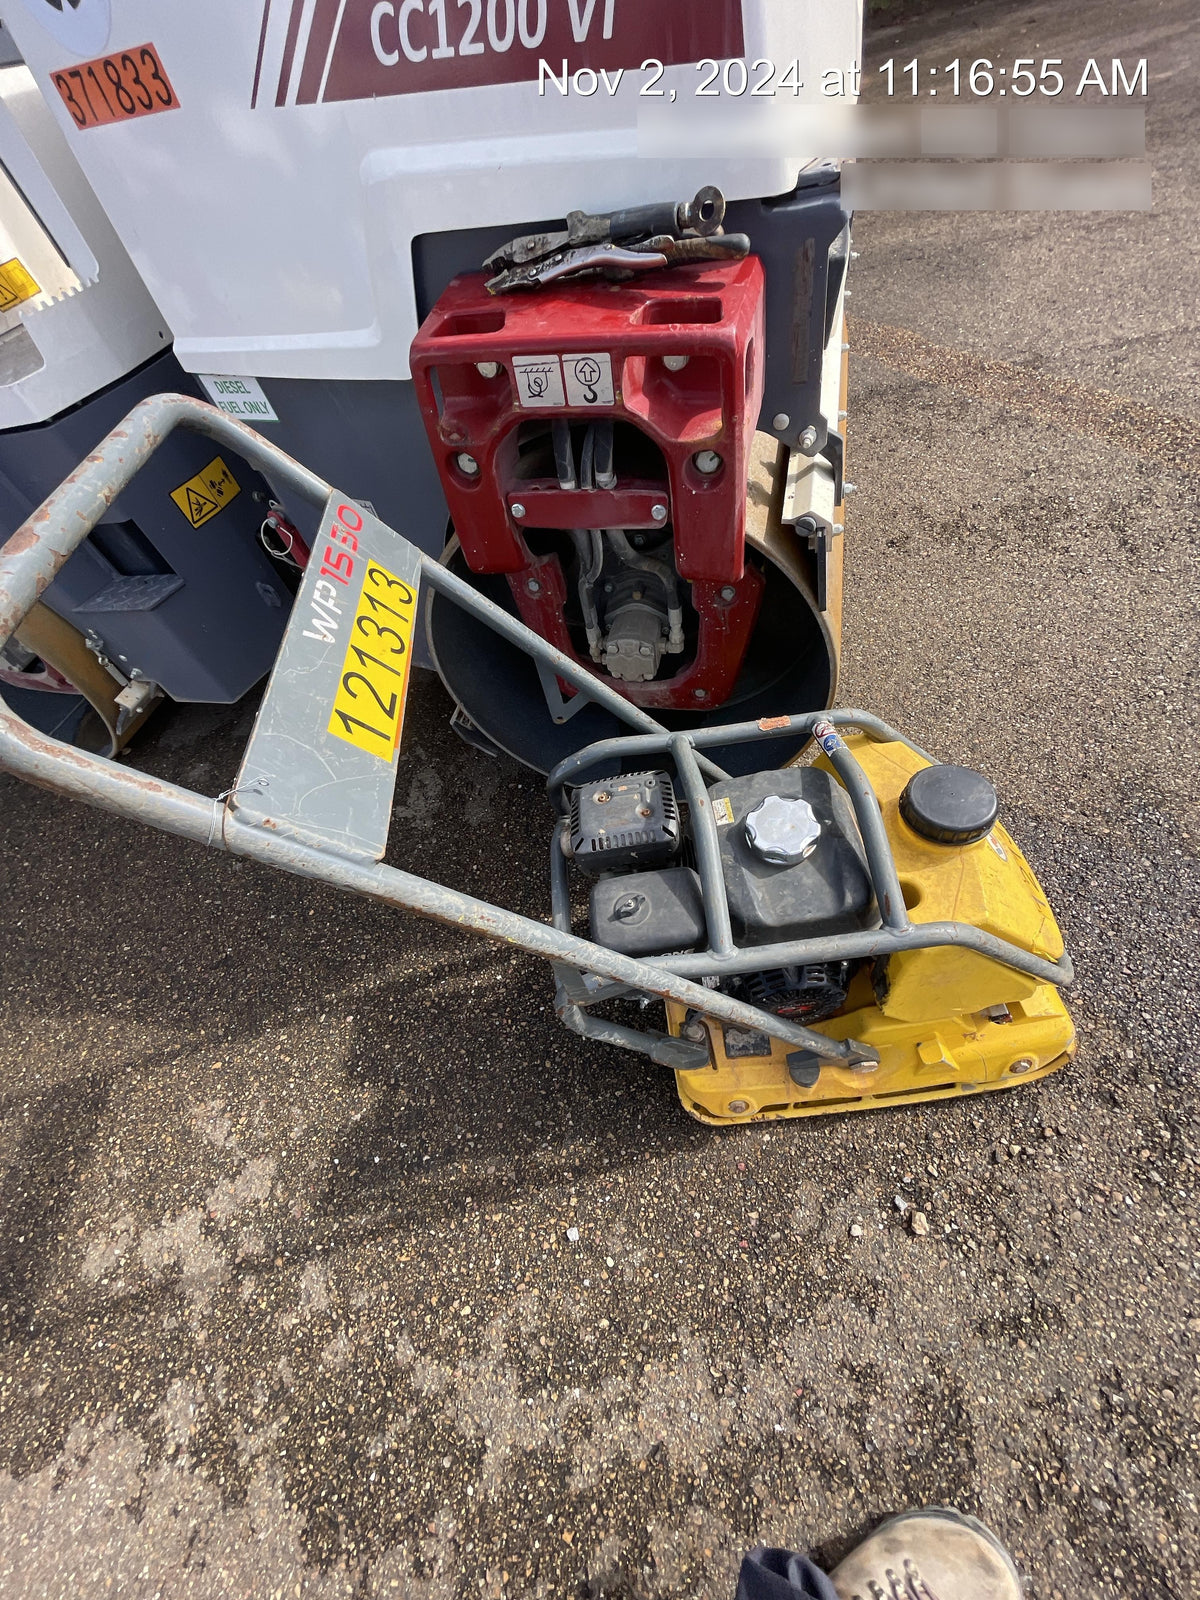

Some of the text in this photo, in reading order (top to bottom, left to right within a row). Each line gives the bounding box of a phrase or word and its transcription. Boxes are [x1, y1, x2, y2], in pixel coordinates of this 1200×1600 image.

[370, 0, 615, 67] CC1200 VI
[55, 48, 172, 126] 371833
[213, 380, 251, 394] DIESEL
[218, 401, 270, 415] FUEL ONLY
[335, 567, 413, 742] 121313
